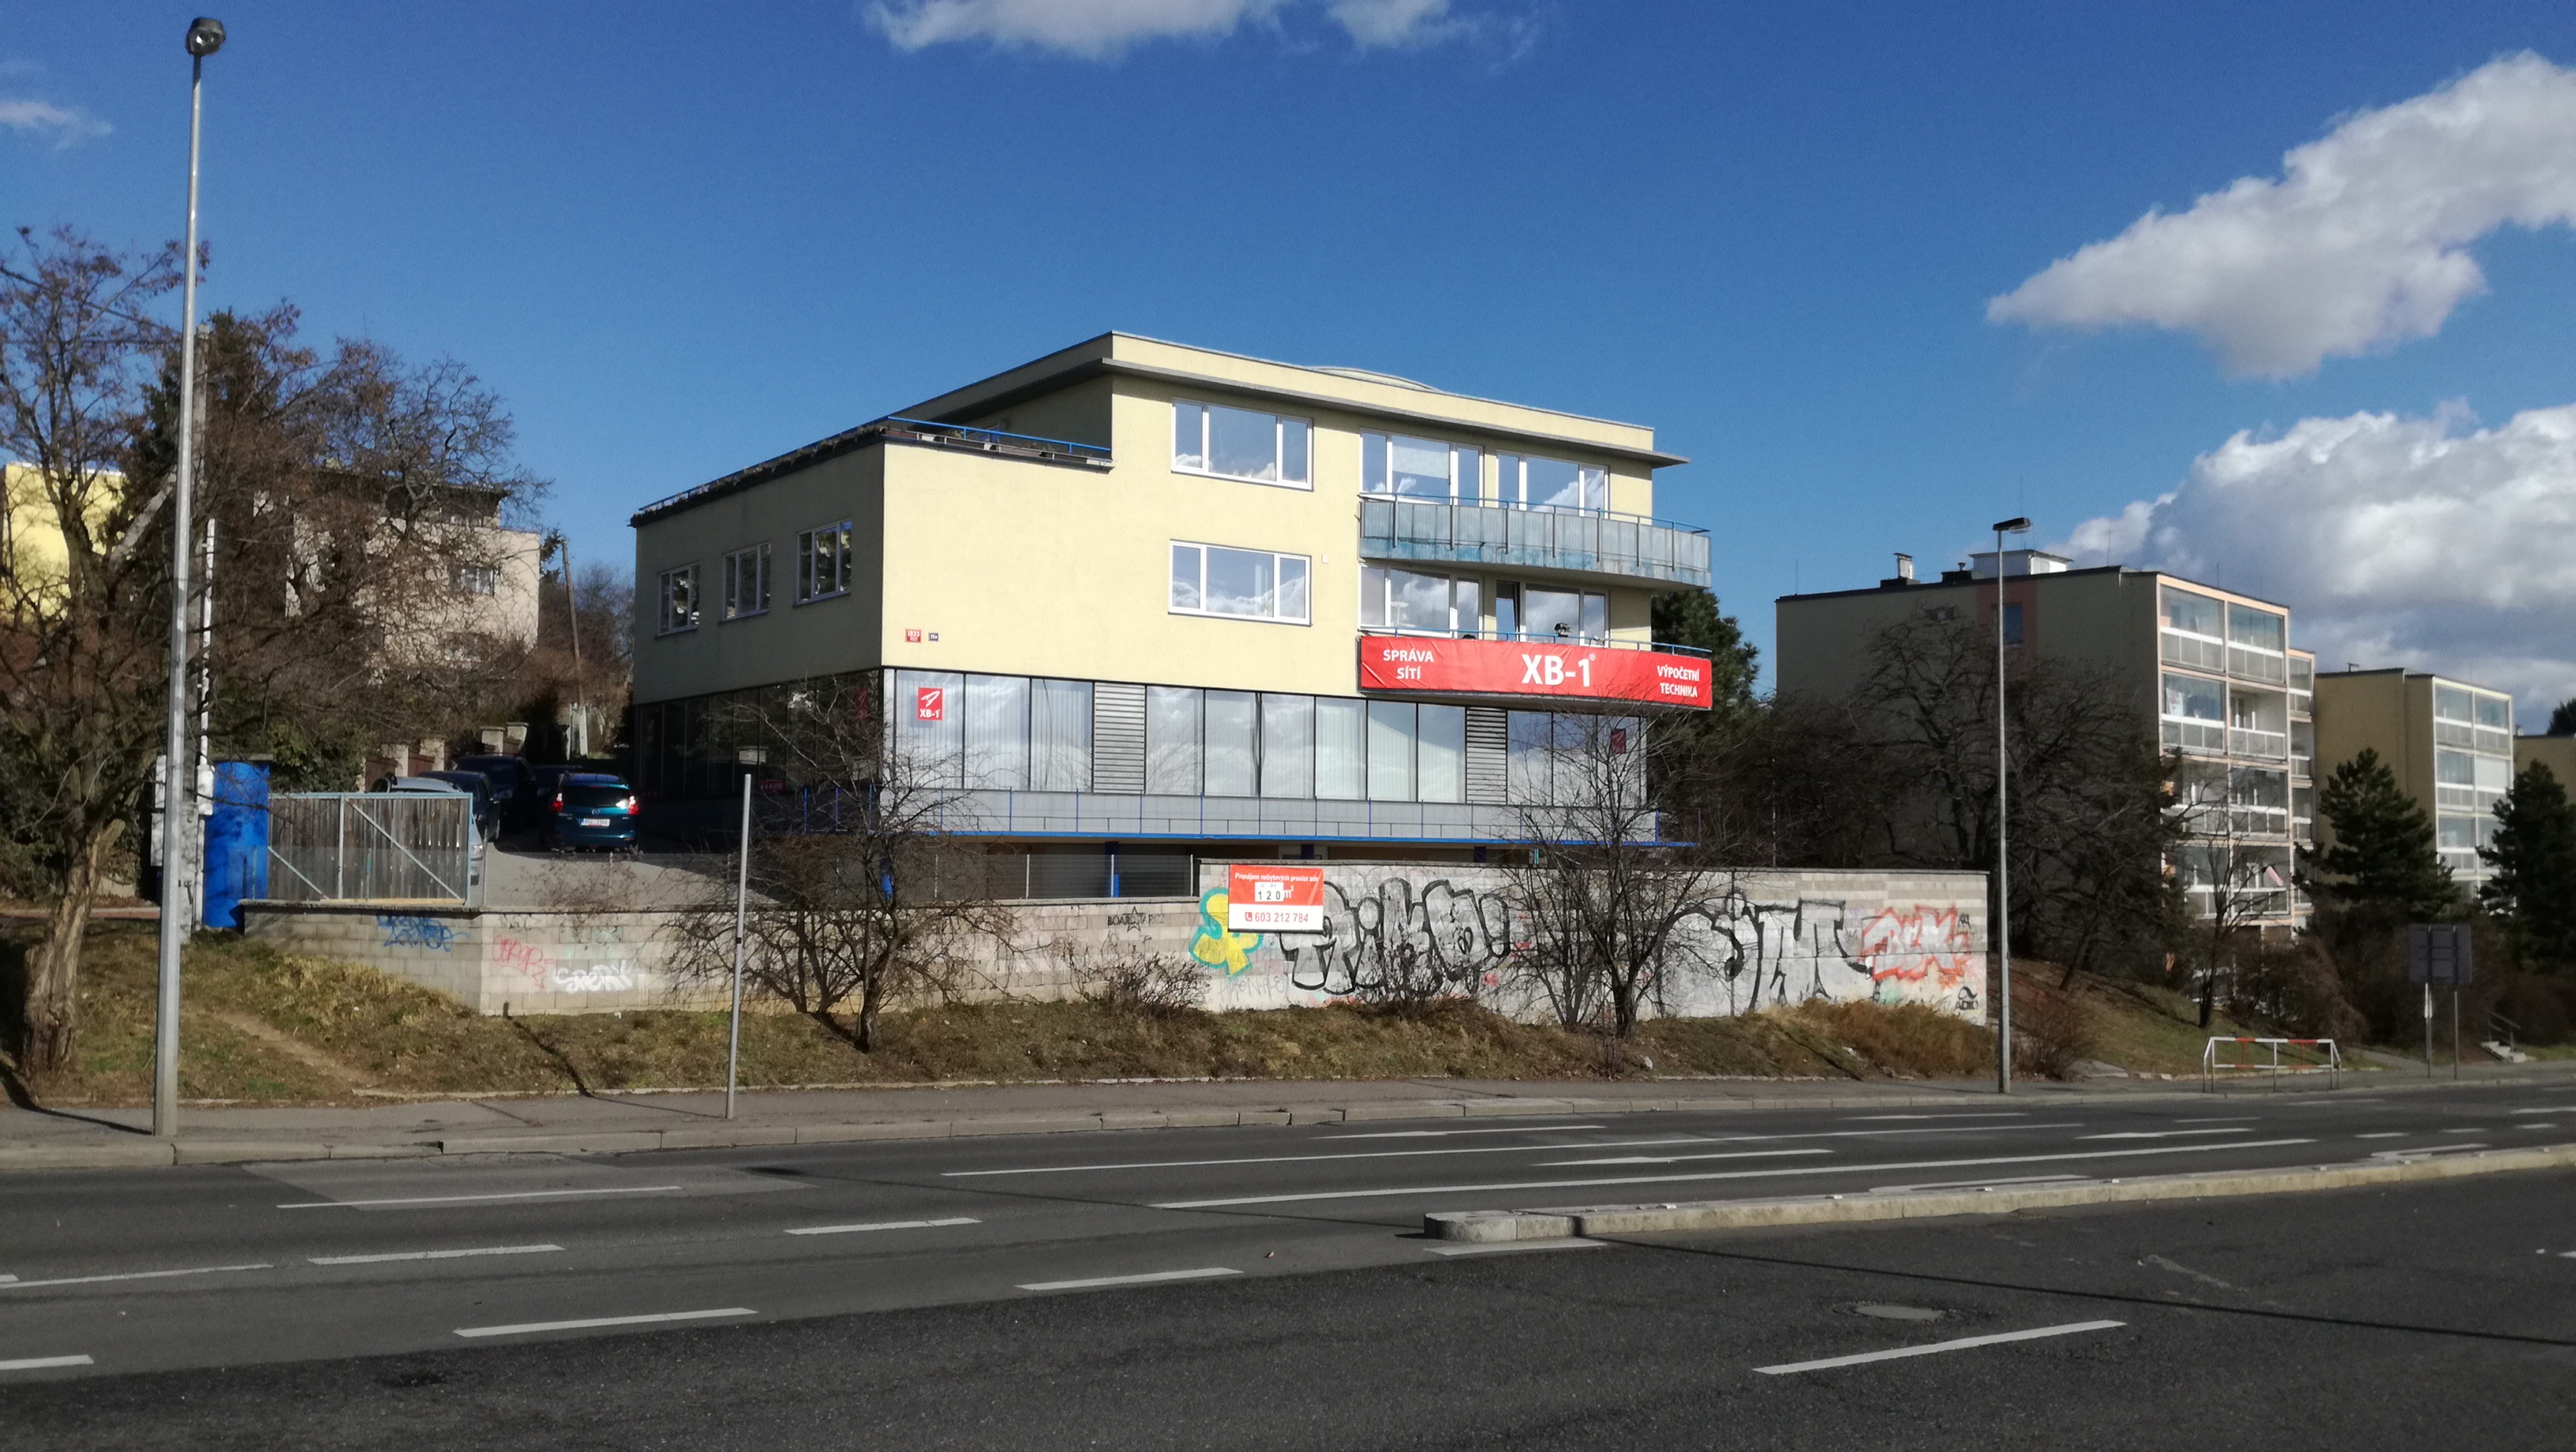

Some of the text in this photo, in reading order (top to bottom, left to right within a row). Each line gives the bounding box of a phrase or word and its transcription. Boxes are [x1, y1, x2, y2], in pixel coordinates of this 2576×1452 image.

[1383, 648, 1434, 662] SPRÁVA
[1397, 665, 1421, 679] SÍTÍ
[1657, 664, 1700, 682] VÝPOČETNÍ
[1660, 683, 1698, 698] TECHNIKA
[1234, 872, 1260, 881] Pronájem
[1260, 874, 1290, 882] nebytových
[1255, 912, 1309, 922] 603 212 784
